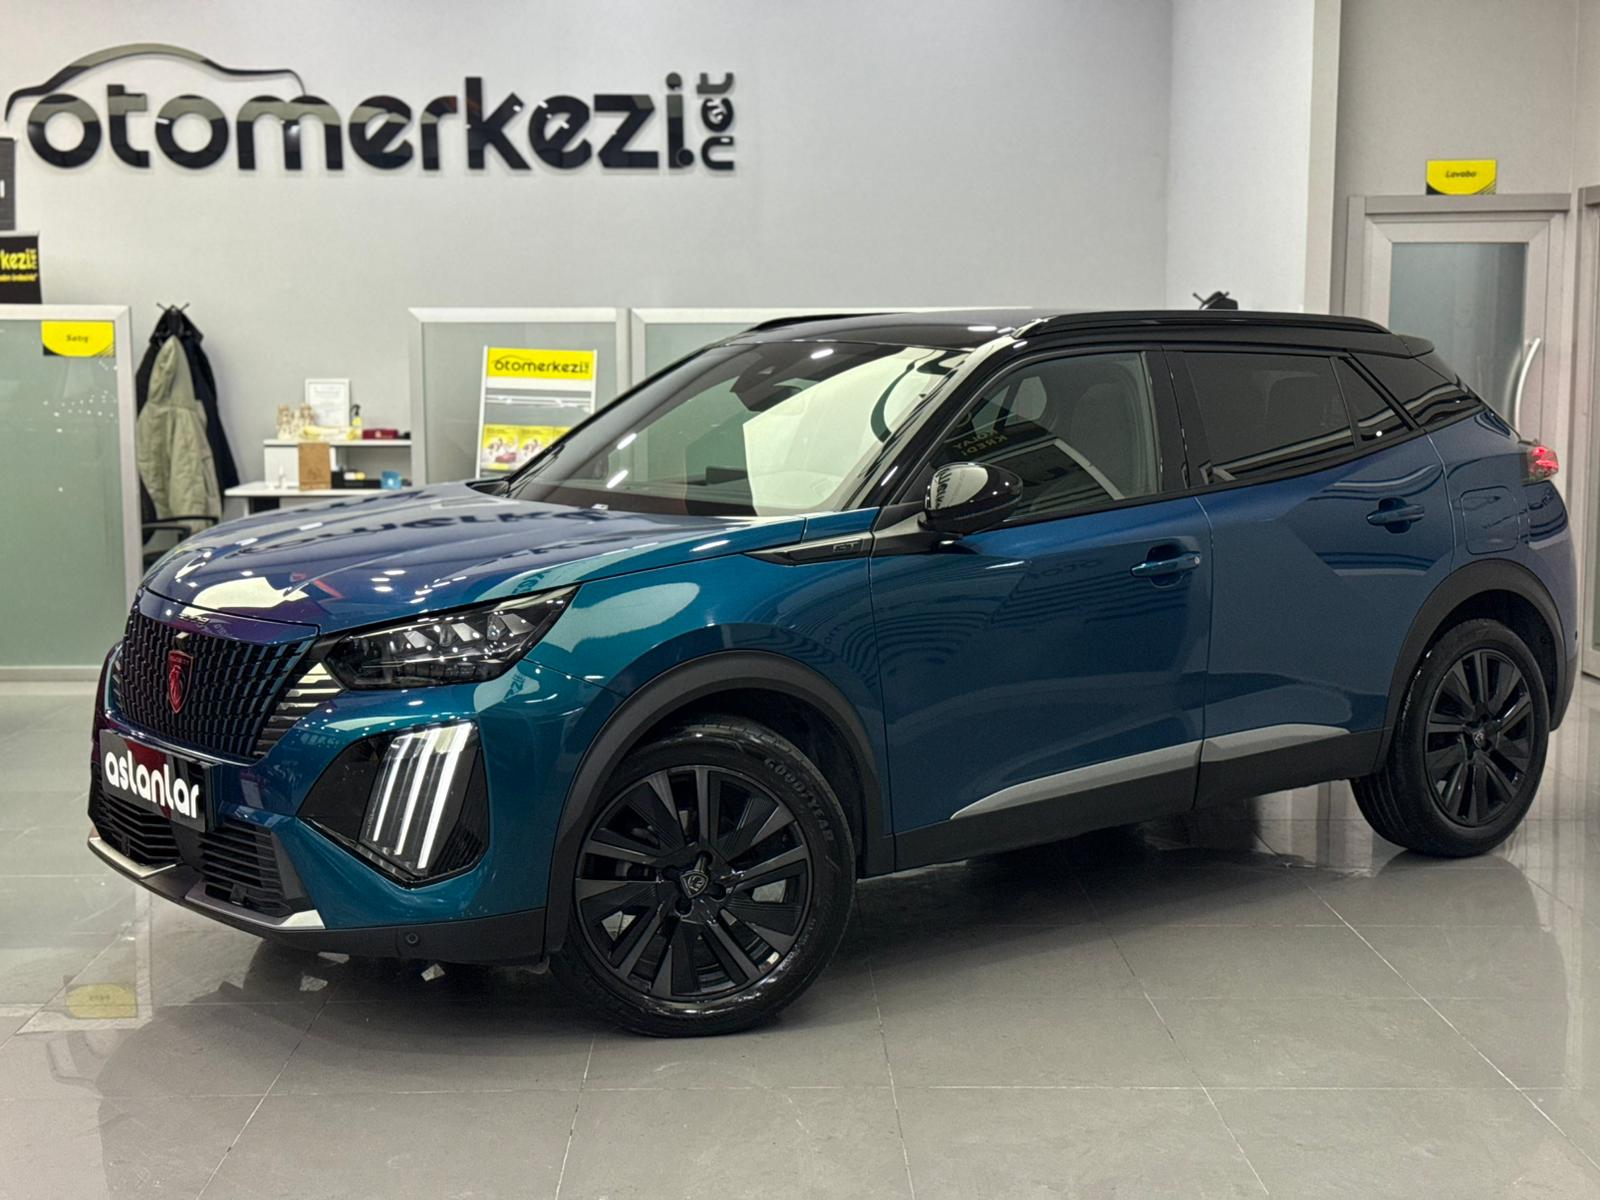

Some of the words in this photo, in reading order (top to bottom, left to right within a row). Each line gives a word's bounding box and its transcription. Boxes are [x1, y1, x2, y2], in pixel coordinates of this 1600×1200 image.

[0, 248, 31, 270] kezi
[104, 750, 200, 819] aslanlar
[764, 757, 834, 842] GOODYEAR
